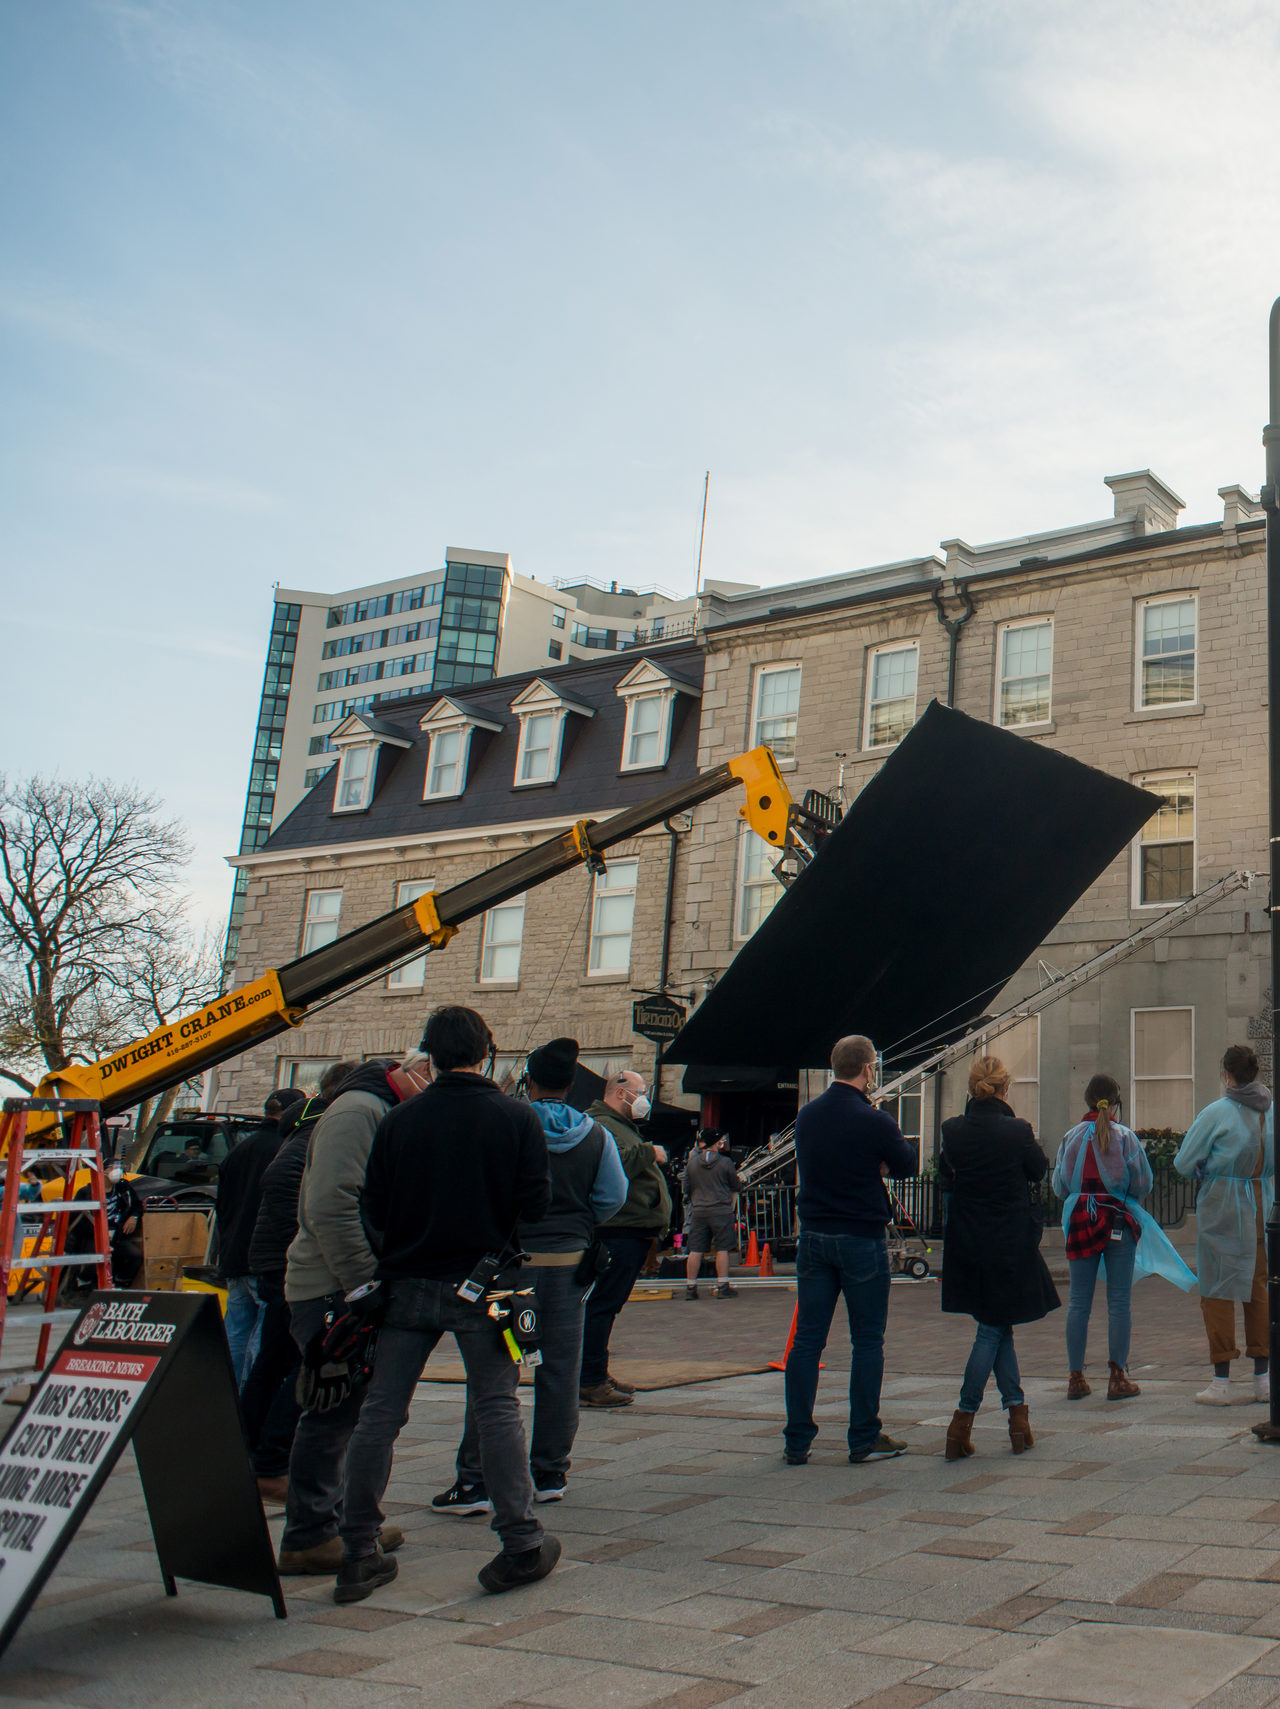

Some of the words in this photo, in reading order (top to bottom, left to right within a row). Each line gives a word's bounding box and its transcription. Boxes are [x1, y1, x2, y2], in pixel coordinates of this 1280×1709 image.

[99, 1031, 173, 1080] DWIGHT
[92, 1321, 177, 1343] LABOURER
[103, 1303, 148, 1321] BATH
[65, 1358, 116, 1373] BREAKING
[114, 1362, 144, 1376] NEWS
[33, 1384, 77, 1417] NHS
[68, 1386, 132, 1424] CRISIS:
[10, 1423, 62, 1459] CUTS
[51, 1427, 110, 1465] MEAN
[0, 1464, 40, 1502] XING
[29, 1469, 88, 1508] MORE
